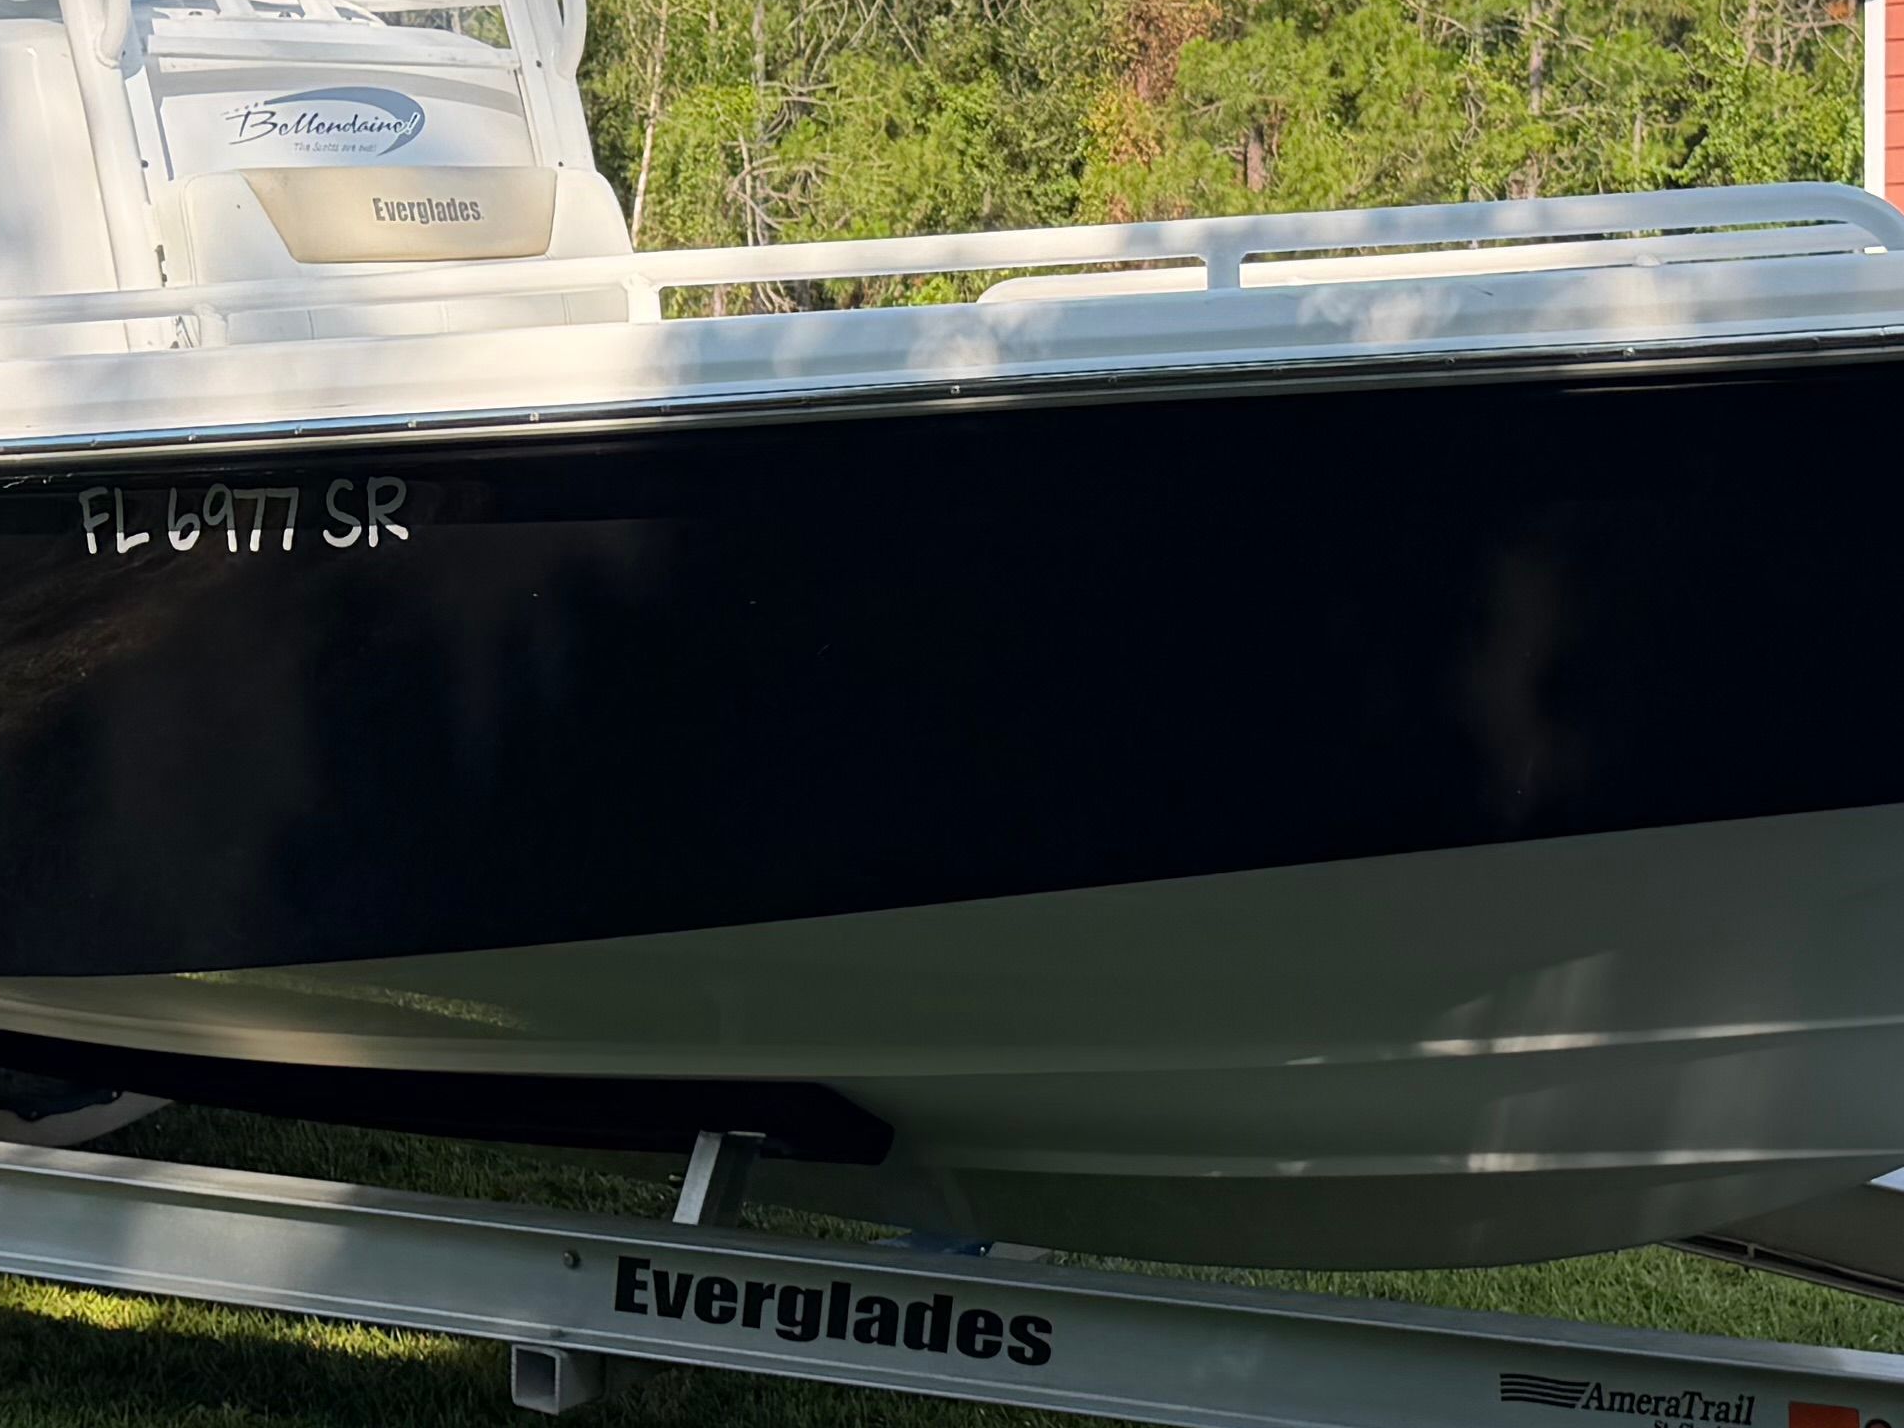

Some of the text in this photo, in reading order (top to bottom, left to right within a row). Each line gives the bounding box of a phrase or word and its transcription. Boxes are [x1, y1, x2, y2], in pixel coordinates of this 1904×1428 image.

[225, 110, 420, 145] Bellendaine!
[372, 197, 482, 225] Everglades
[78, 477, 409, 554] FL 6977 SR
[613, 1255, 1054, 1367] Everglades
[1582, 1382, 1756, 1426] AmeraTrail
